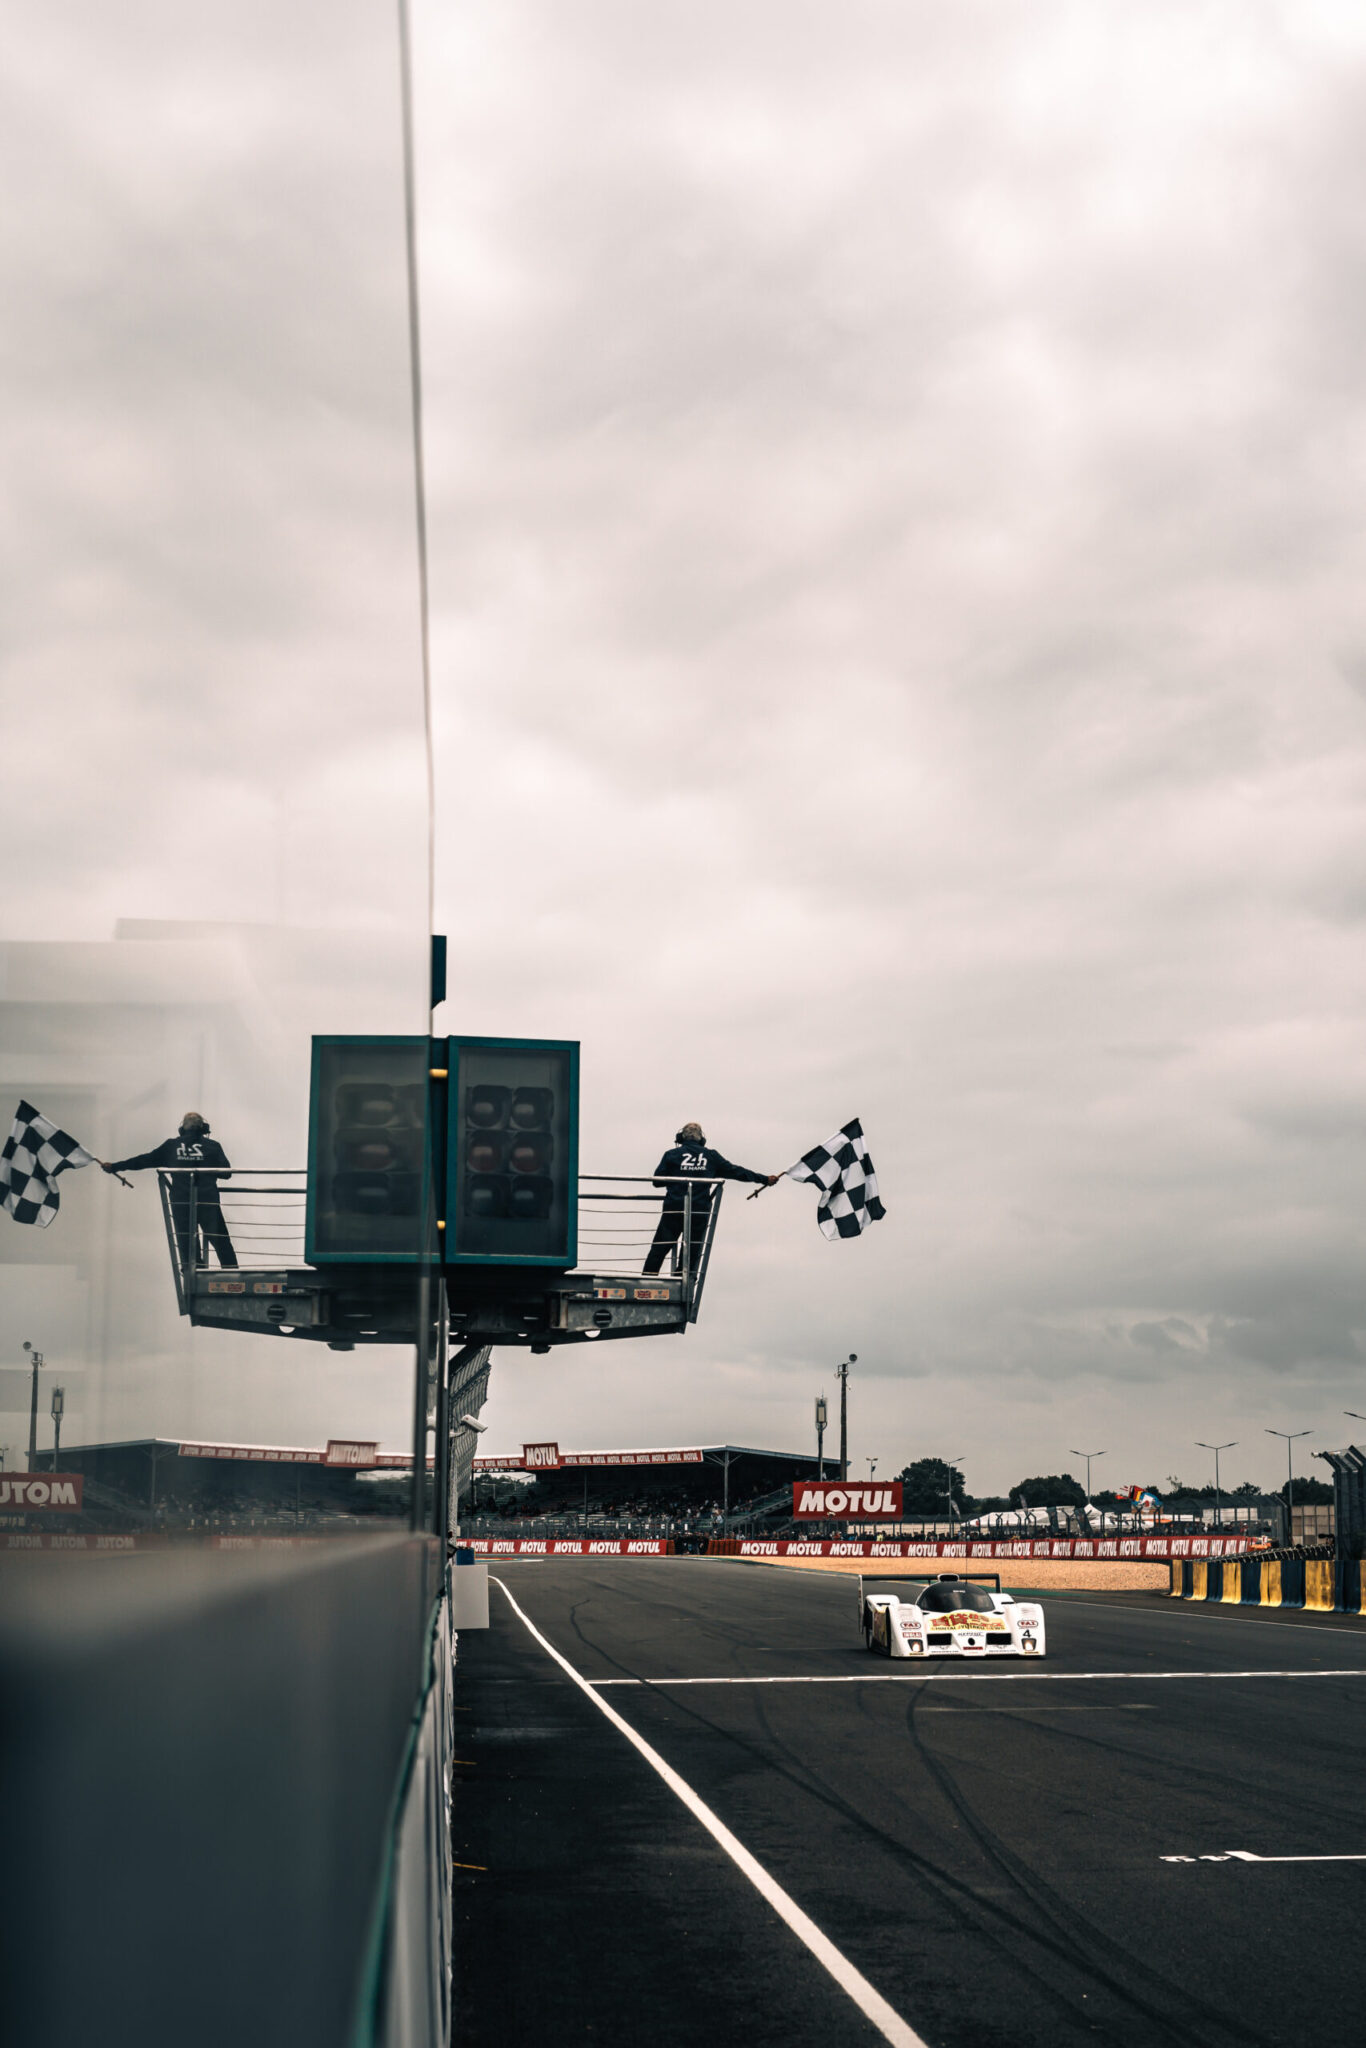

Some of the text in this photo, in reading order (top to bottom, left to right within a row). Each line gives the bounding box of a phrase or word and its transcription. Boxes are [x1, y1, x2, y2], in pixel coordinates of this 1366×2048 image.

[526, 1447, 558, 1466] MOTUL
[798, 1490, 896, 1512] MOTUL
[492, 1541, 514, 1552] MOTUL
[519, 1541, 547, 1553] MOTUL
[554, 1541, 582, 1553] MOTUL
[588, 1541, 621, 1553] MOTUL
[627, 1541, 660, 1553] MOTUL
[741, 1542, 778, 1554] MOTUL
[786, 1543, 822, 1555] MOTUL
[830, 1543, 864, 1555] MOTUL
[870, 1543, 902, 1556] MOTUL
[908, 1544, 938, 1556] MOTUL
[942, 1544, 966, 1557] MOTUL
[971, 1544, 992, 1556] MOTUL
[1145, 1540, 1168, 1555] MOTUL
[1022, 1629, 1032, 1638] 4
